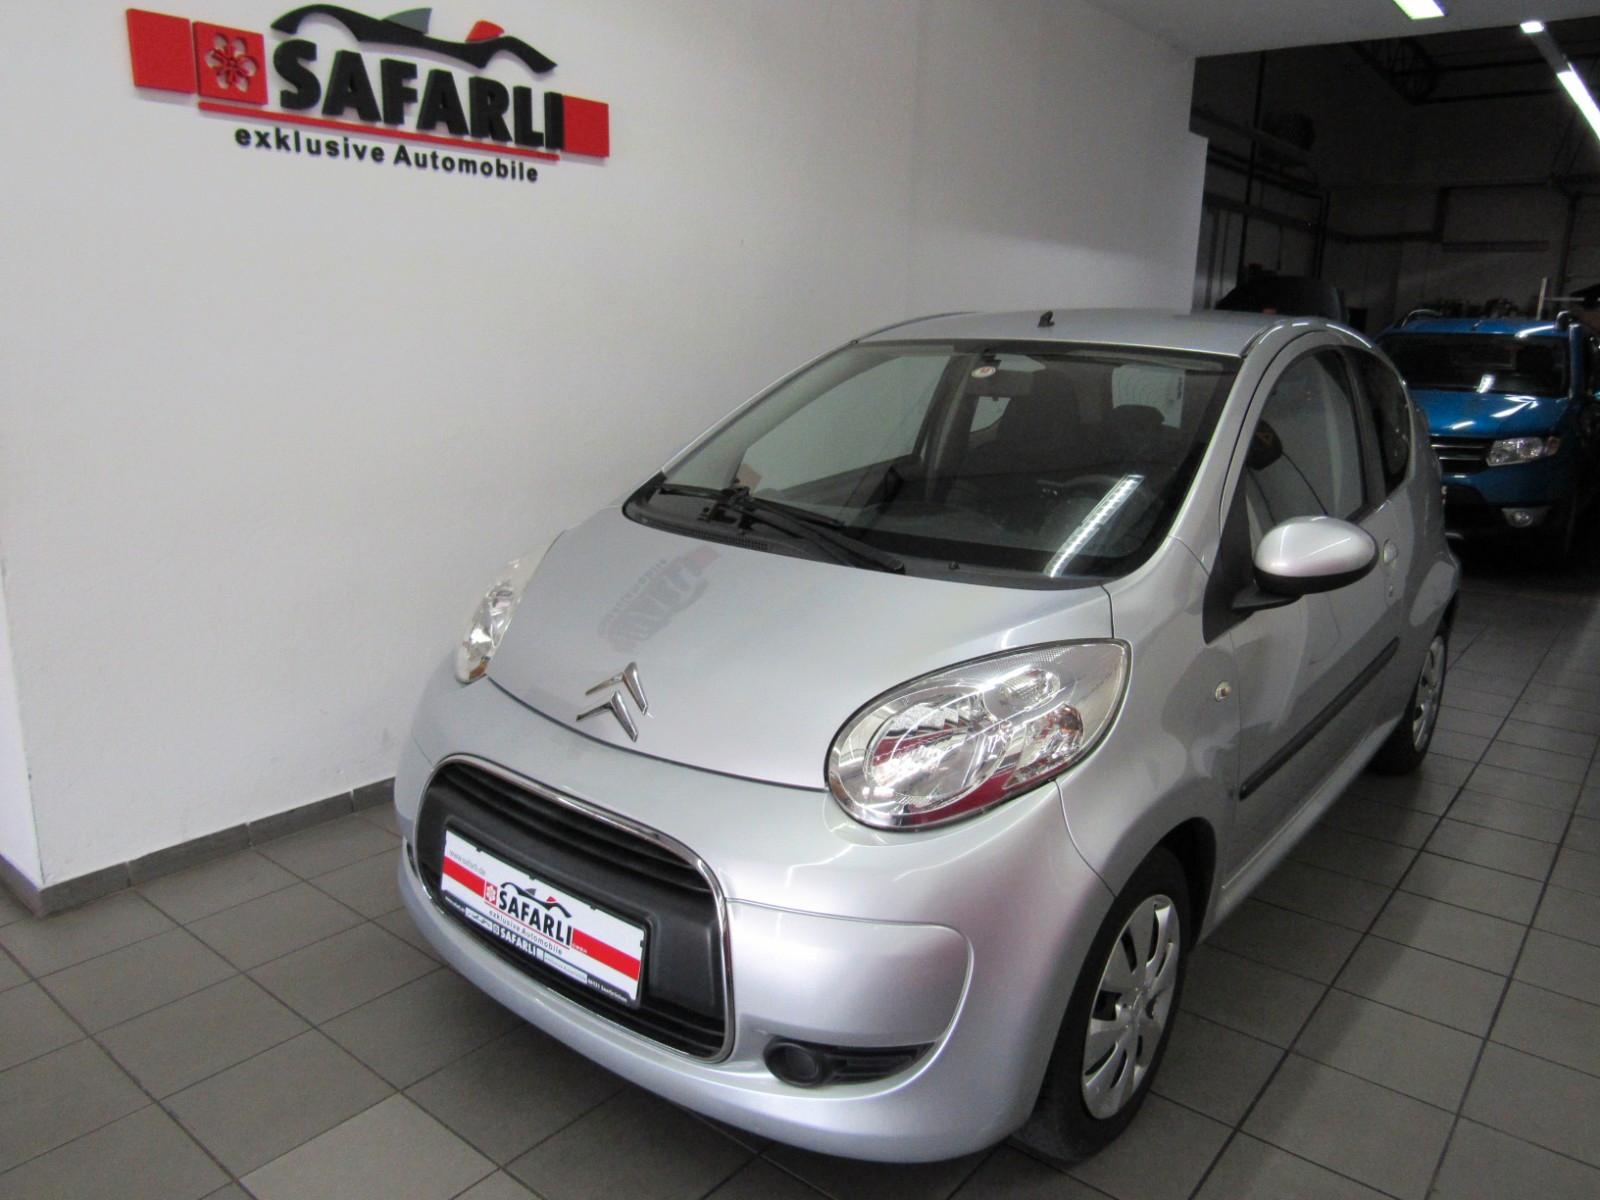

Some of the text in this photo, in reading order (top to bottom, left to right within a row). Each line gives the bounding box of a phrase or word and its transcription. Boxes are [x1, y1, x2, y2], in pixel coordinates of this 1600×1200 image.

[273, 39, 563, 150] SAFARLI
[234, 127, 538, 182] exklusive Automobile
[499, 890, 572, 946] SAFARLI
[500, 925, 536, 957] SAFARLI
